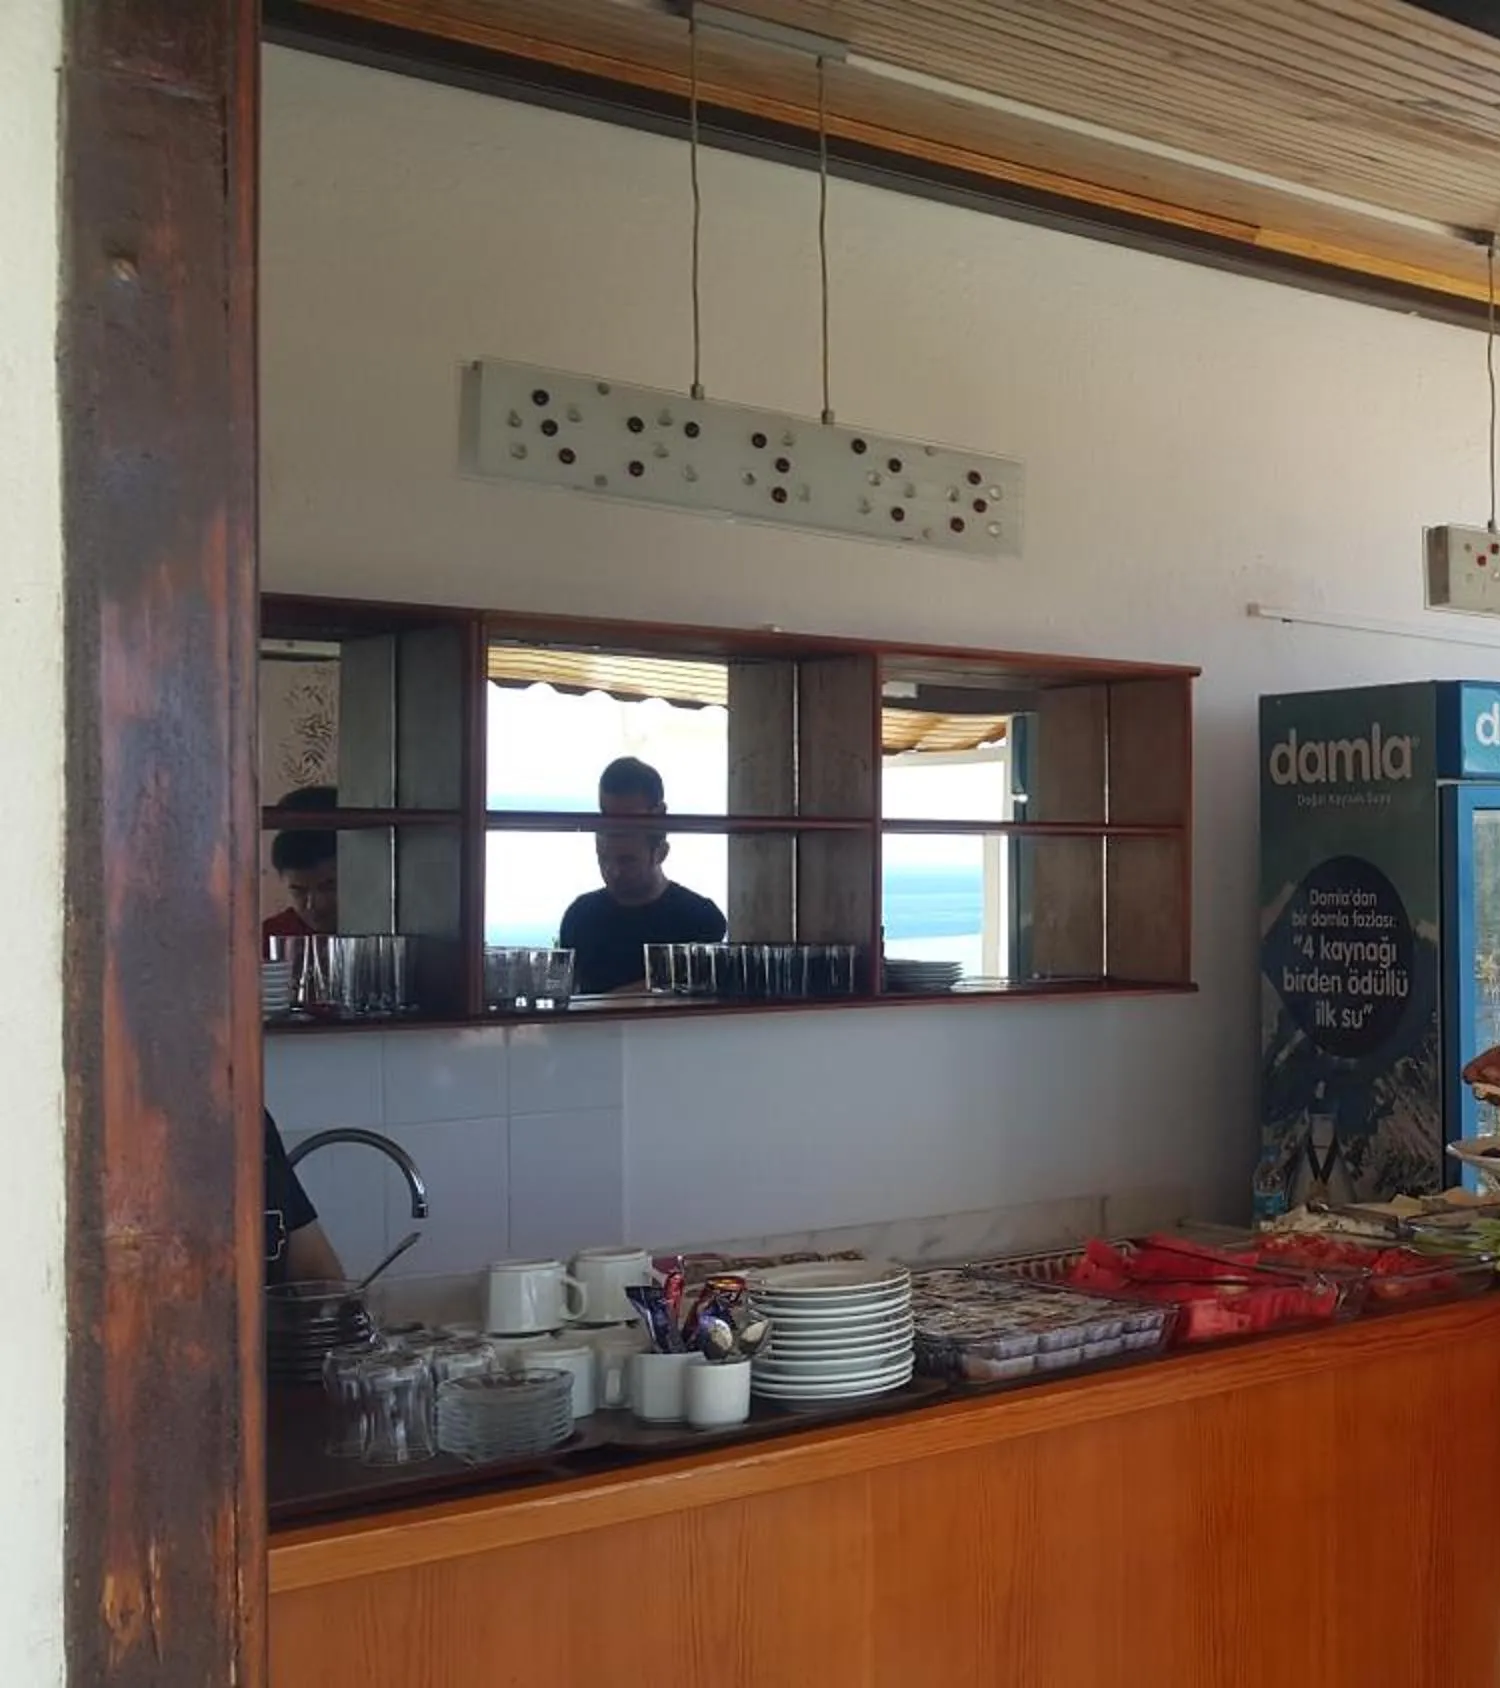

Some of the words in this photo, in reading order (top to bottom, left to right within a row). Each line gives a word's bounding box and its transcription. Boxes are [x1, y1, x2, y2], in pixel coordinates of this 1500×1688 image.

[1269, 721, 1412, 786] damla
[1320, 934, 1397, 969] kaynağı
[1283, 966, 1342, 993] birden
[1347, 967, 1409, 997] ödüllü
[1315, 999, 1338, 1029] ilk
